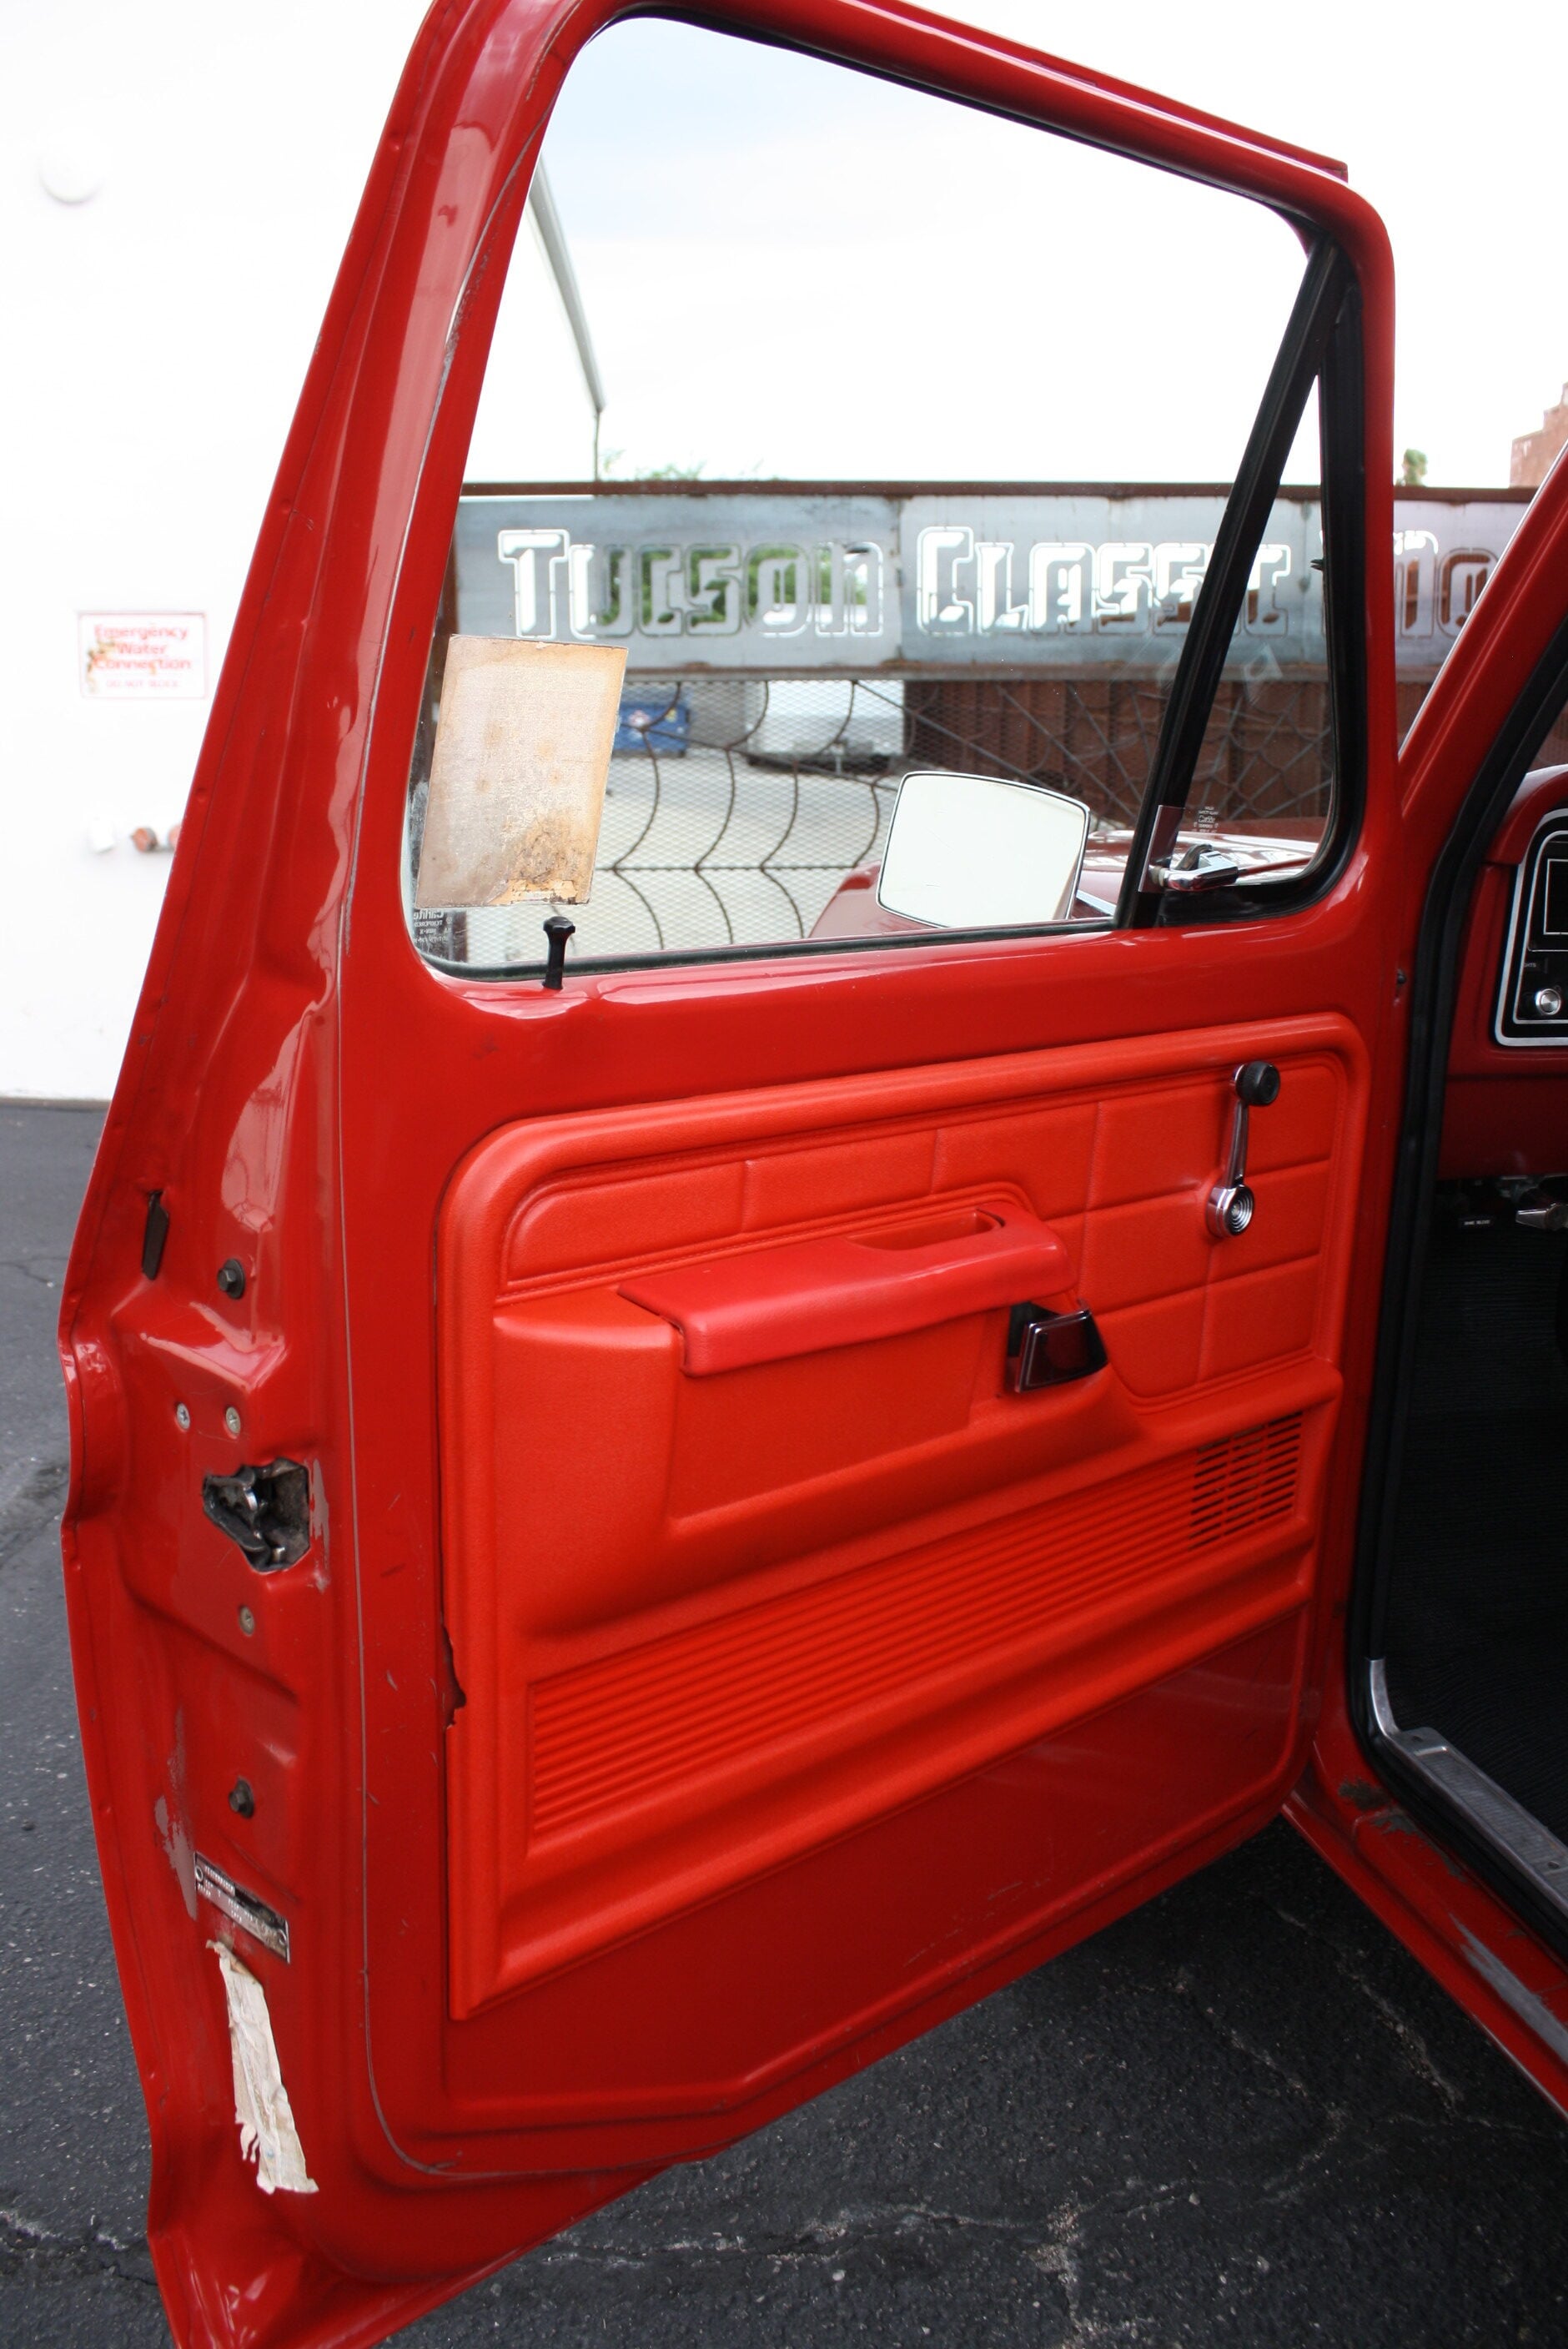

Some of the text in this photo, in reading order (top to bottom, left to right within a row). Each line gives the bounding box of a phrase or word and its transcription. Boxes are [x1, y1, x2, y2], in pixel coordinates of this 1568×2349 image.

[94, 625, 188, 640] Emergency
[116, 642, 167, 655] Water
[93, 657, 191, 669] Connection
